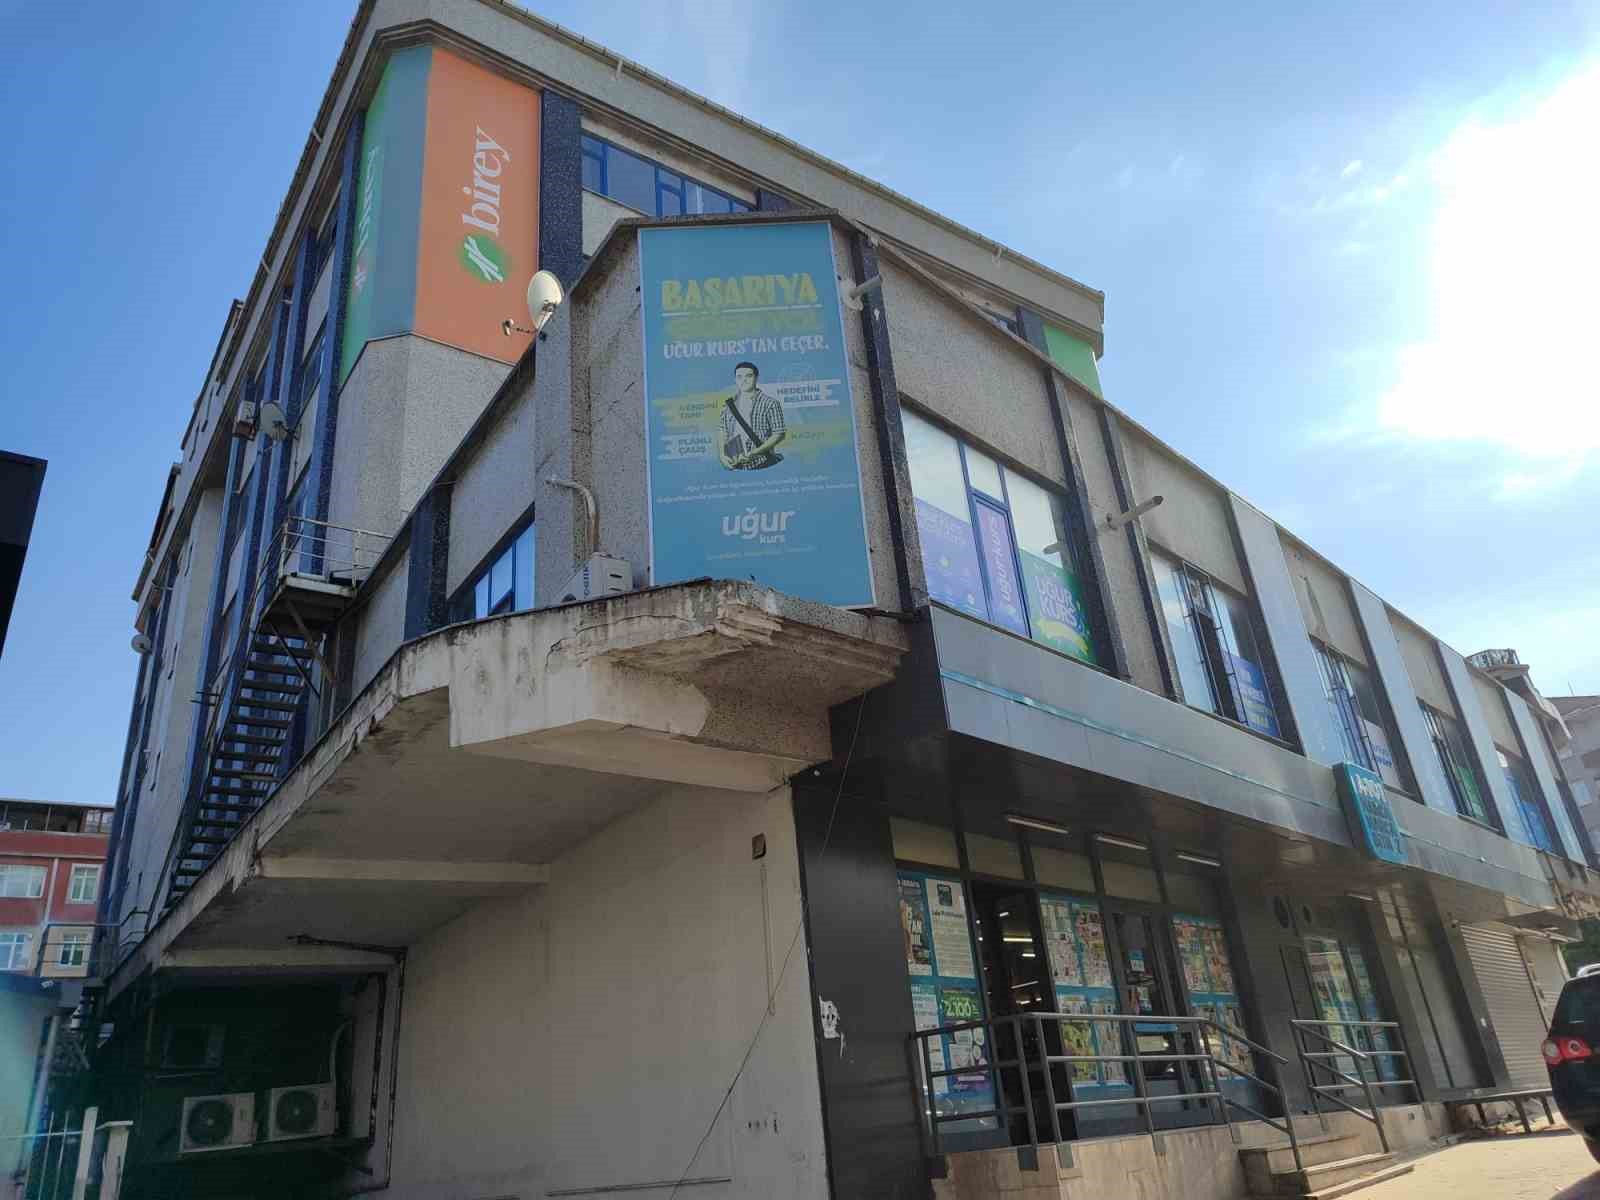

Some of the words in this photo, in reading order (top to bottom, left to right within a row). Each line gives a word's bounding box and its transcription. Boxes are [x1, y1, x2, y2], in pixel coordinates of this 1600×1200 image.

[462, 124, 512, 236] birey
[661, 273, 818, 313] BAŞARIYA
[722, 506, 796, 540] uğur
[759, 533, 786, 545] kurs
